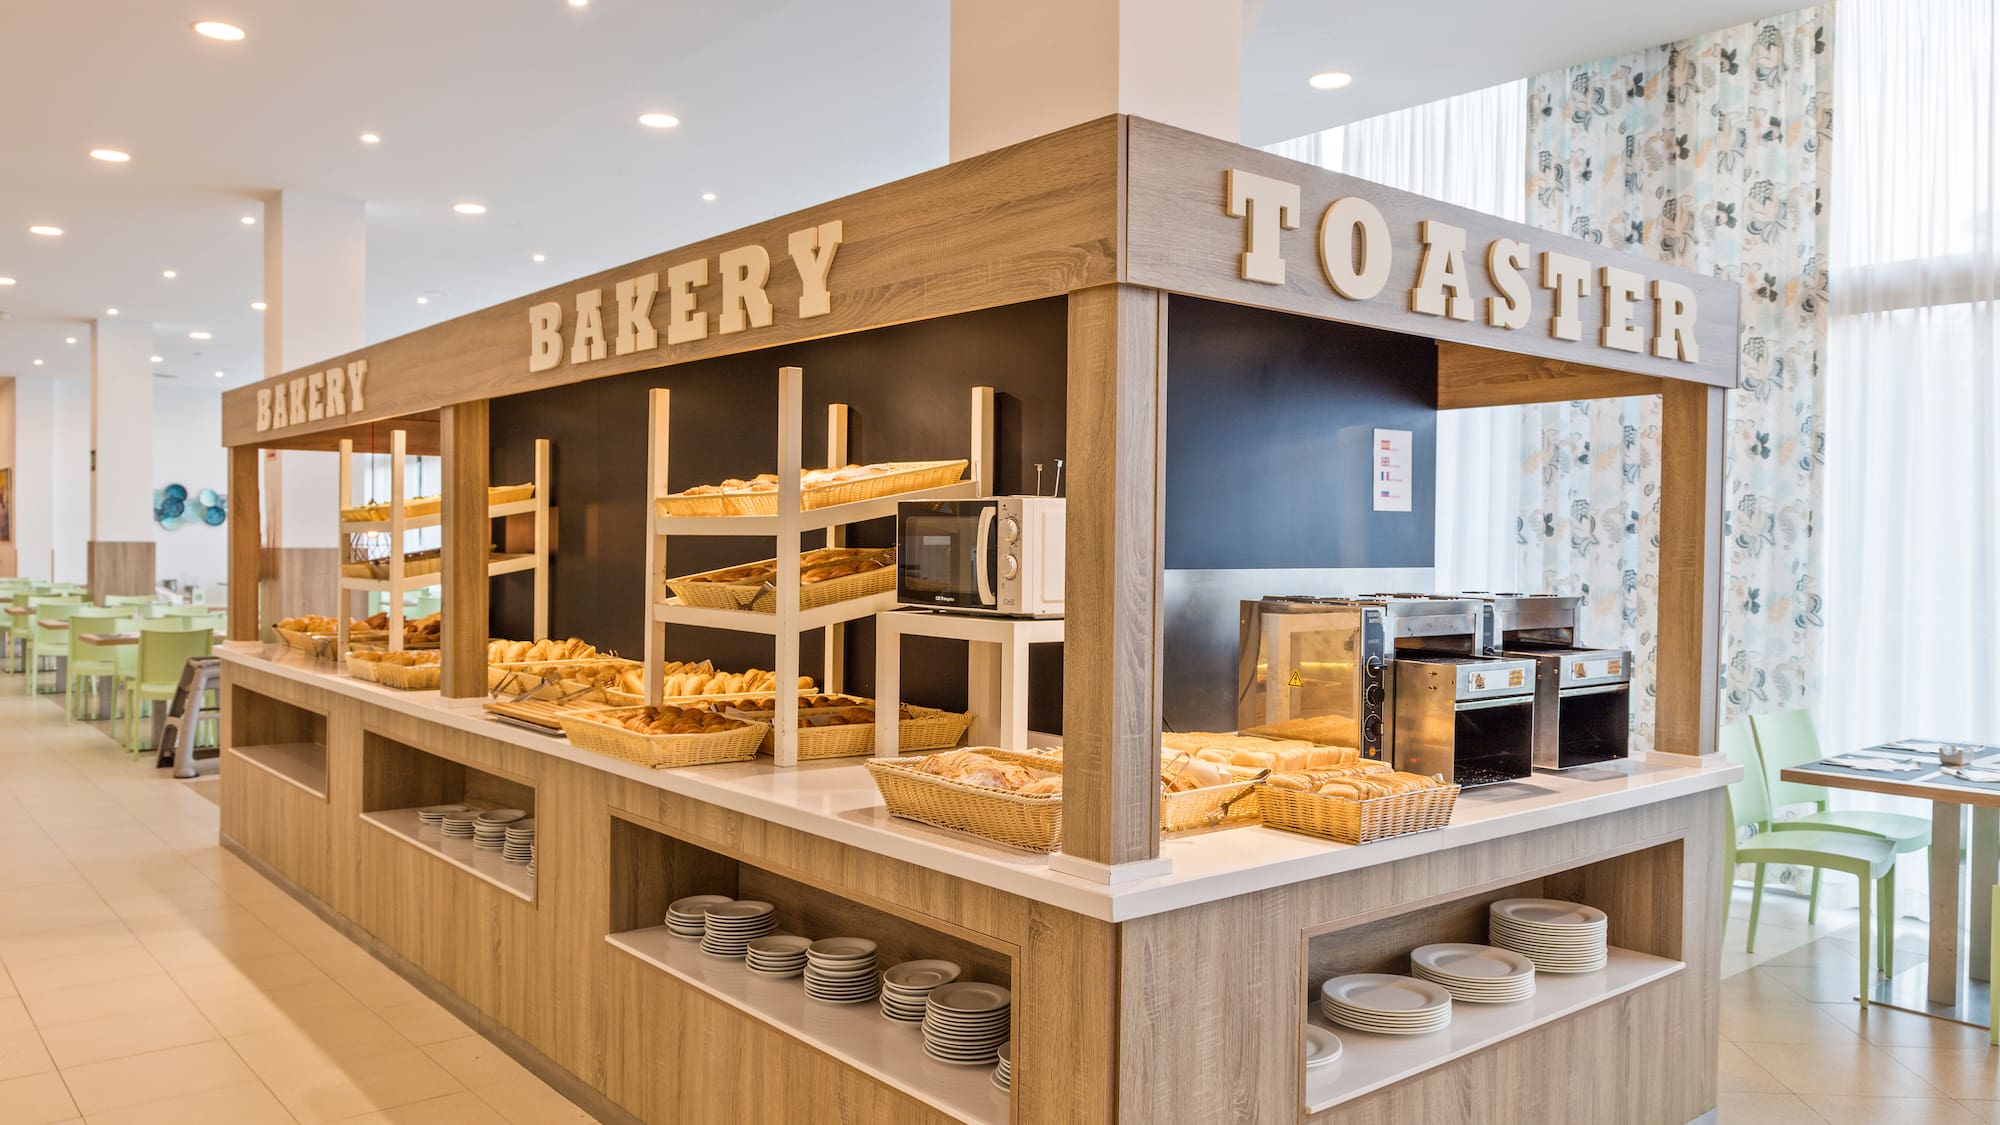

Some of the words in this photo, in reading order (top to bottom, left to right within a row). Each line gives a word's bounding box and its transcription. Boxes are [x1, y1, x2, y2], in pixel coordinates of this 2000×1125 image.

[529, 220, 843, 373] BAKERY
[1226, 168, 1700, 363] TOASTER
[256, 359, 368, 432] BAKERY
